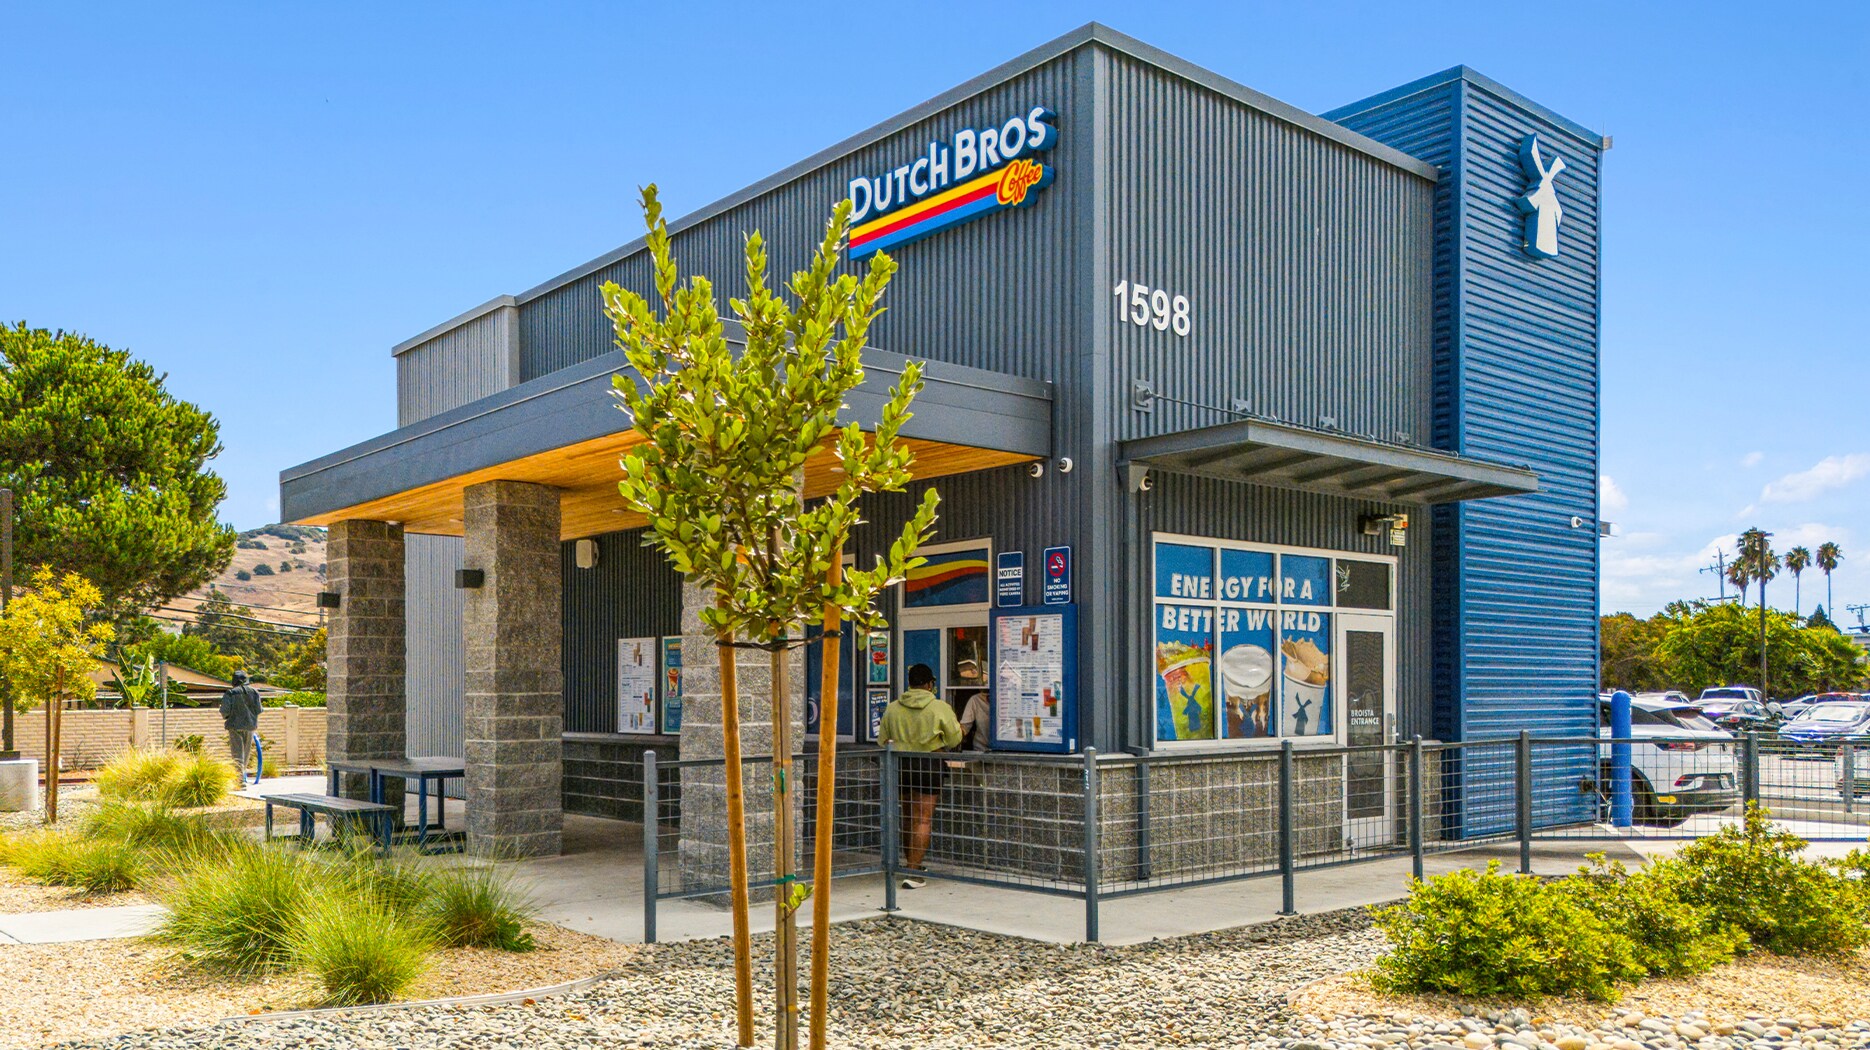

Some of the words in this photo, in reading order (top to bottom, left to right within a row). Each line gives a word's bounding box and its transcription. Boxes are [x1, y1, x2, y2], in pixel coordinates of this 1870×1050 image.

[849, 141, 948, 224] DUTCH
[954, 106, 1047, 181] BROS
[999, 159, 1042, 204] Coffee
[1114, 279, 1191, 337] 1598
[1000, 569, 1022, 577] NOTICE
[1299, 579, 1313, 600] A
[1350, 709, 1375, 717] BROISTA
[1350, 717, 1379, 726] ENTRANCE
